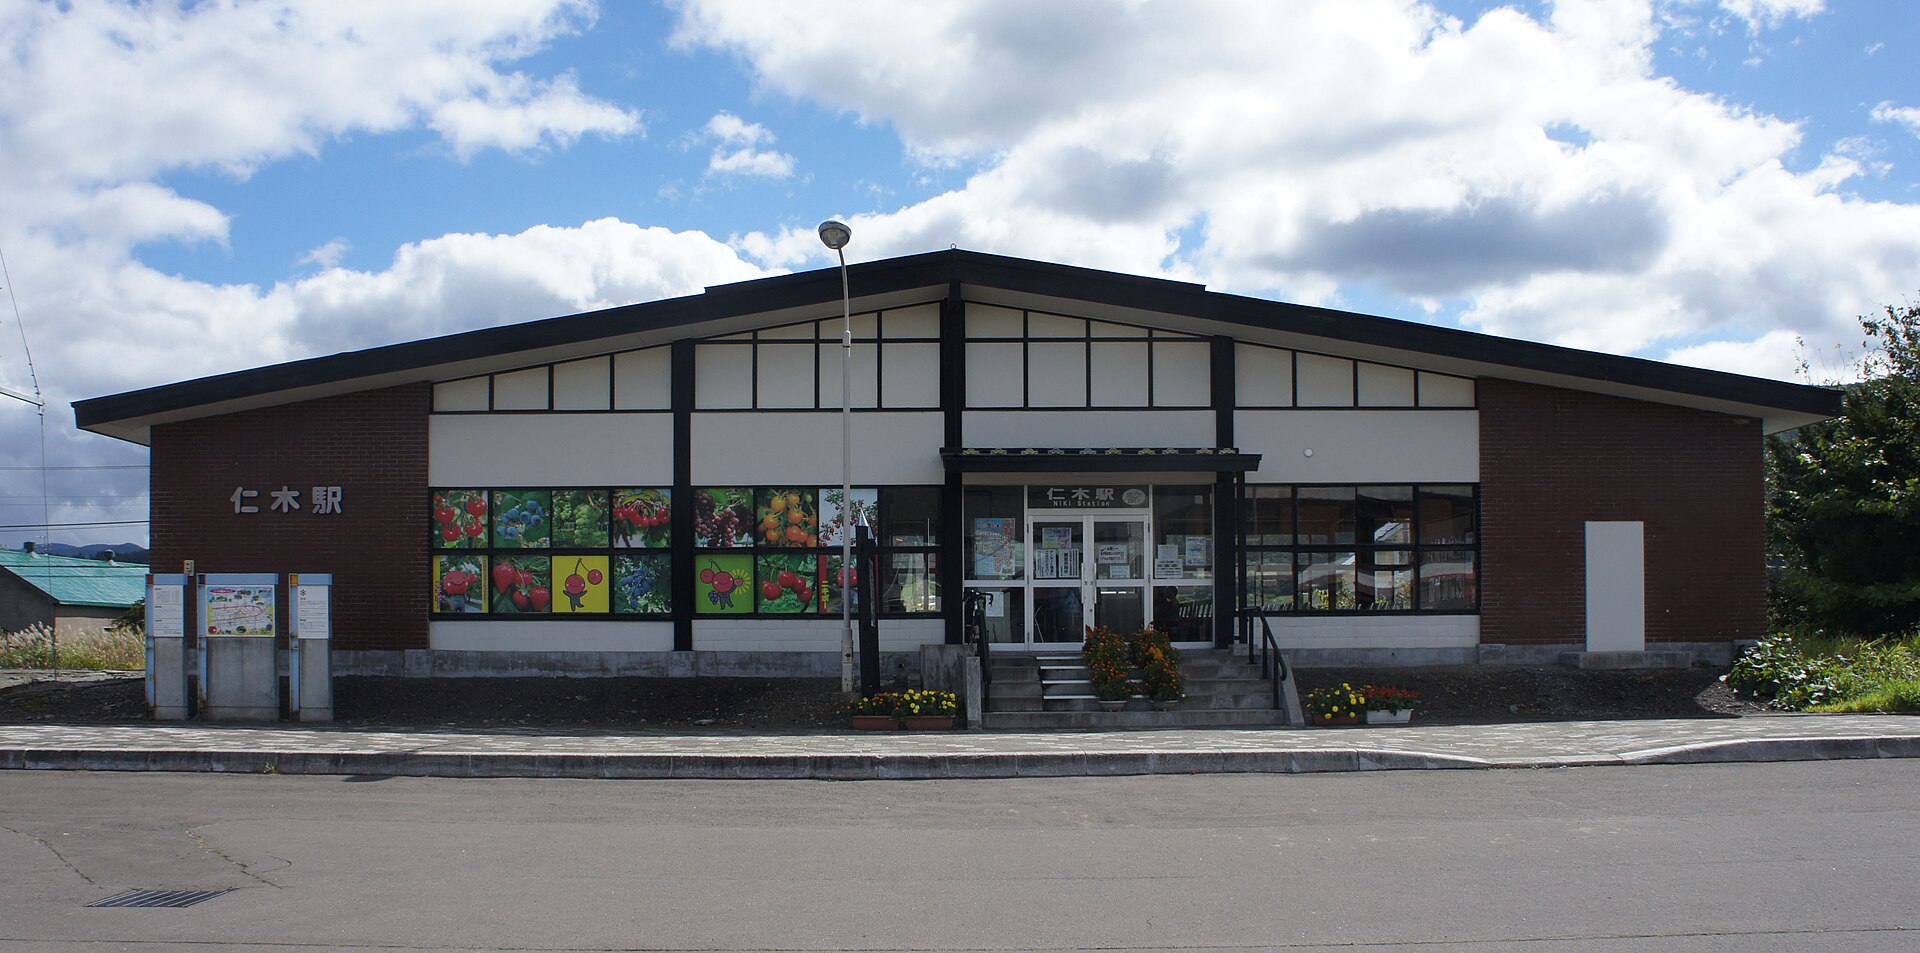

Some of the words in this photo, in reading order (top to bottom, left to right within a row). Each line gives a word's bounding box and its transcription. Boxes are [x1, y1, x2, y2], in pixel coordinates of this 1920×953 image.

[230, 486, 343, 514] 仁木駅
[1047, 488, 1114, 500] 仁木駅
